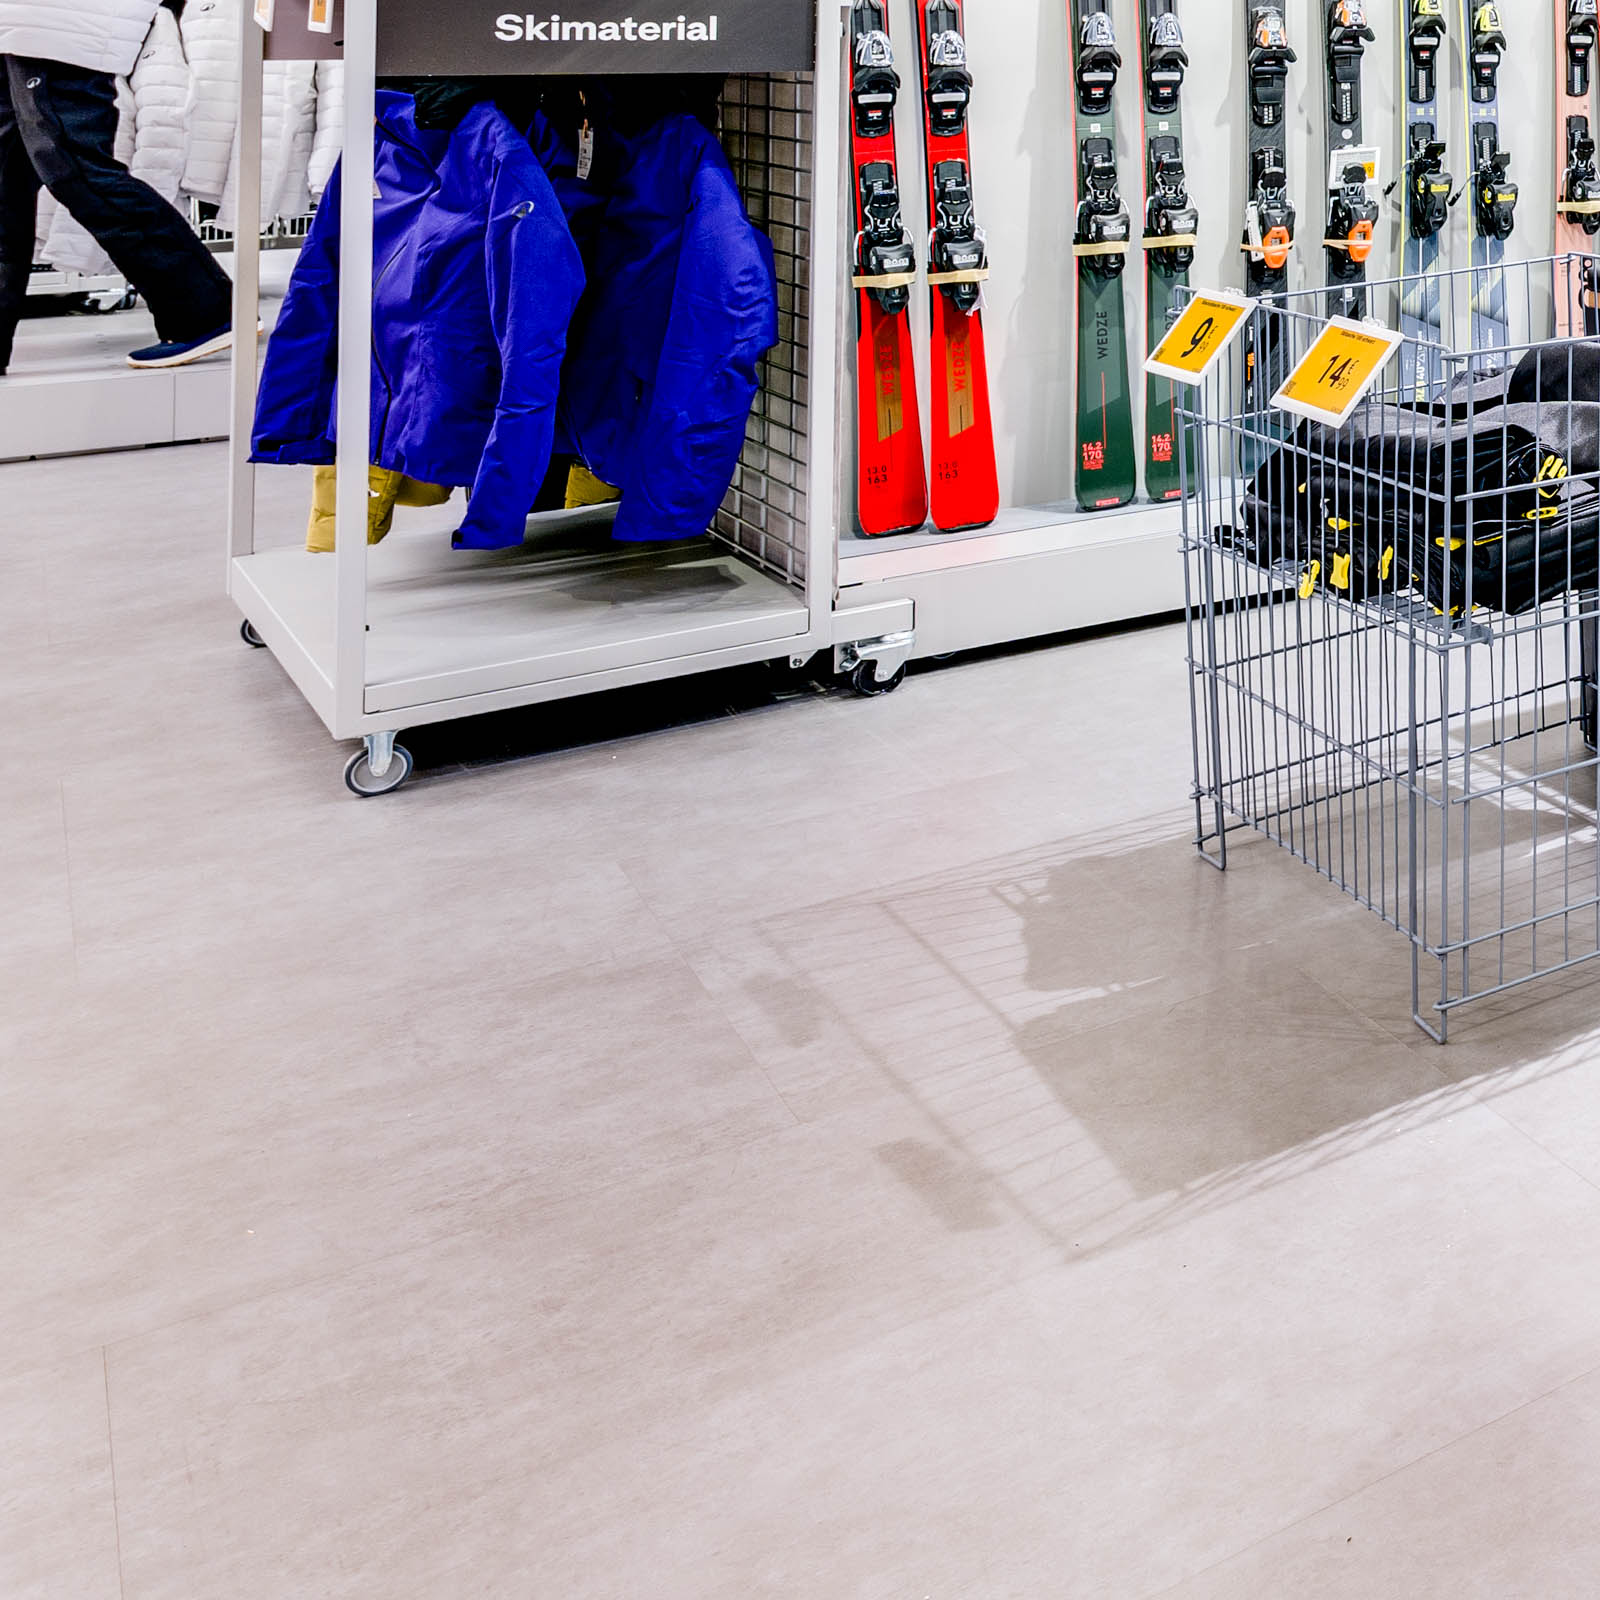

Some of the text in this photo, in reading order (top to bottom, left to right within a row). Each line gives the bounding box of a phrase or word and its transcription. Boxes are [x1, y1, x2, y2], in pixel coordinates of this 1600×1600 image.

[494, 14, 718, 42] Skimaterial
[1097, 311, 1108, 360] WEDZE
[882, 344, 894, 396] WEDZE
[953, 341, 965, 393] WEDZE
[1318, 354, 1352, 387] 14
[1082, 440, 1102, 451] 14.2
[1152, 434, 1171, 444] 14.2
[1152, 442, 1171, 453] 170
[1083, 450, 1103, 461] 170
[867, 474, 888, 485] 163
